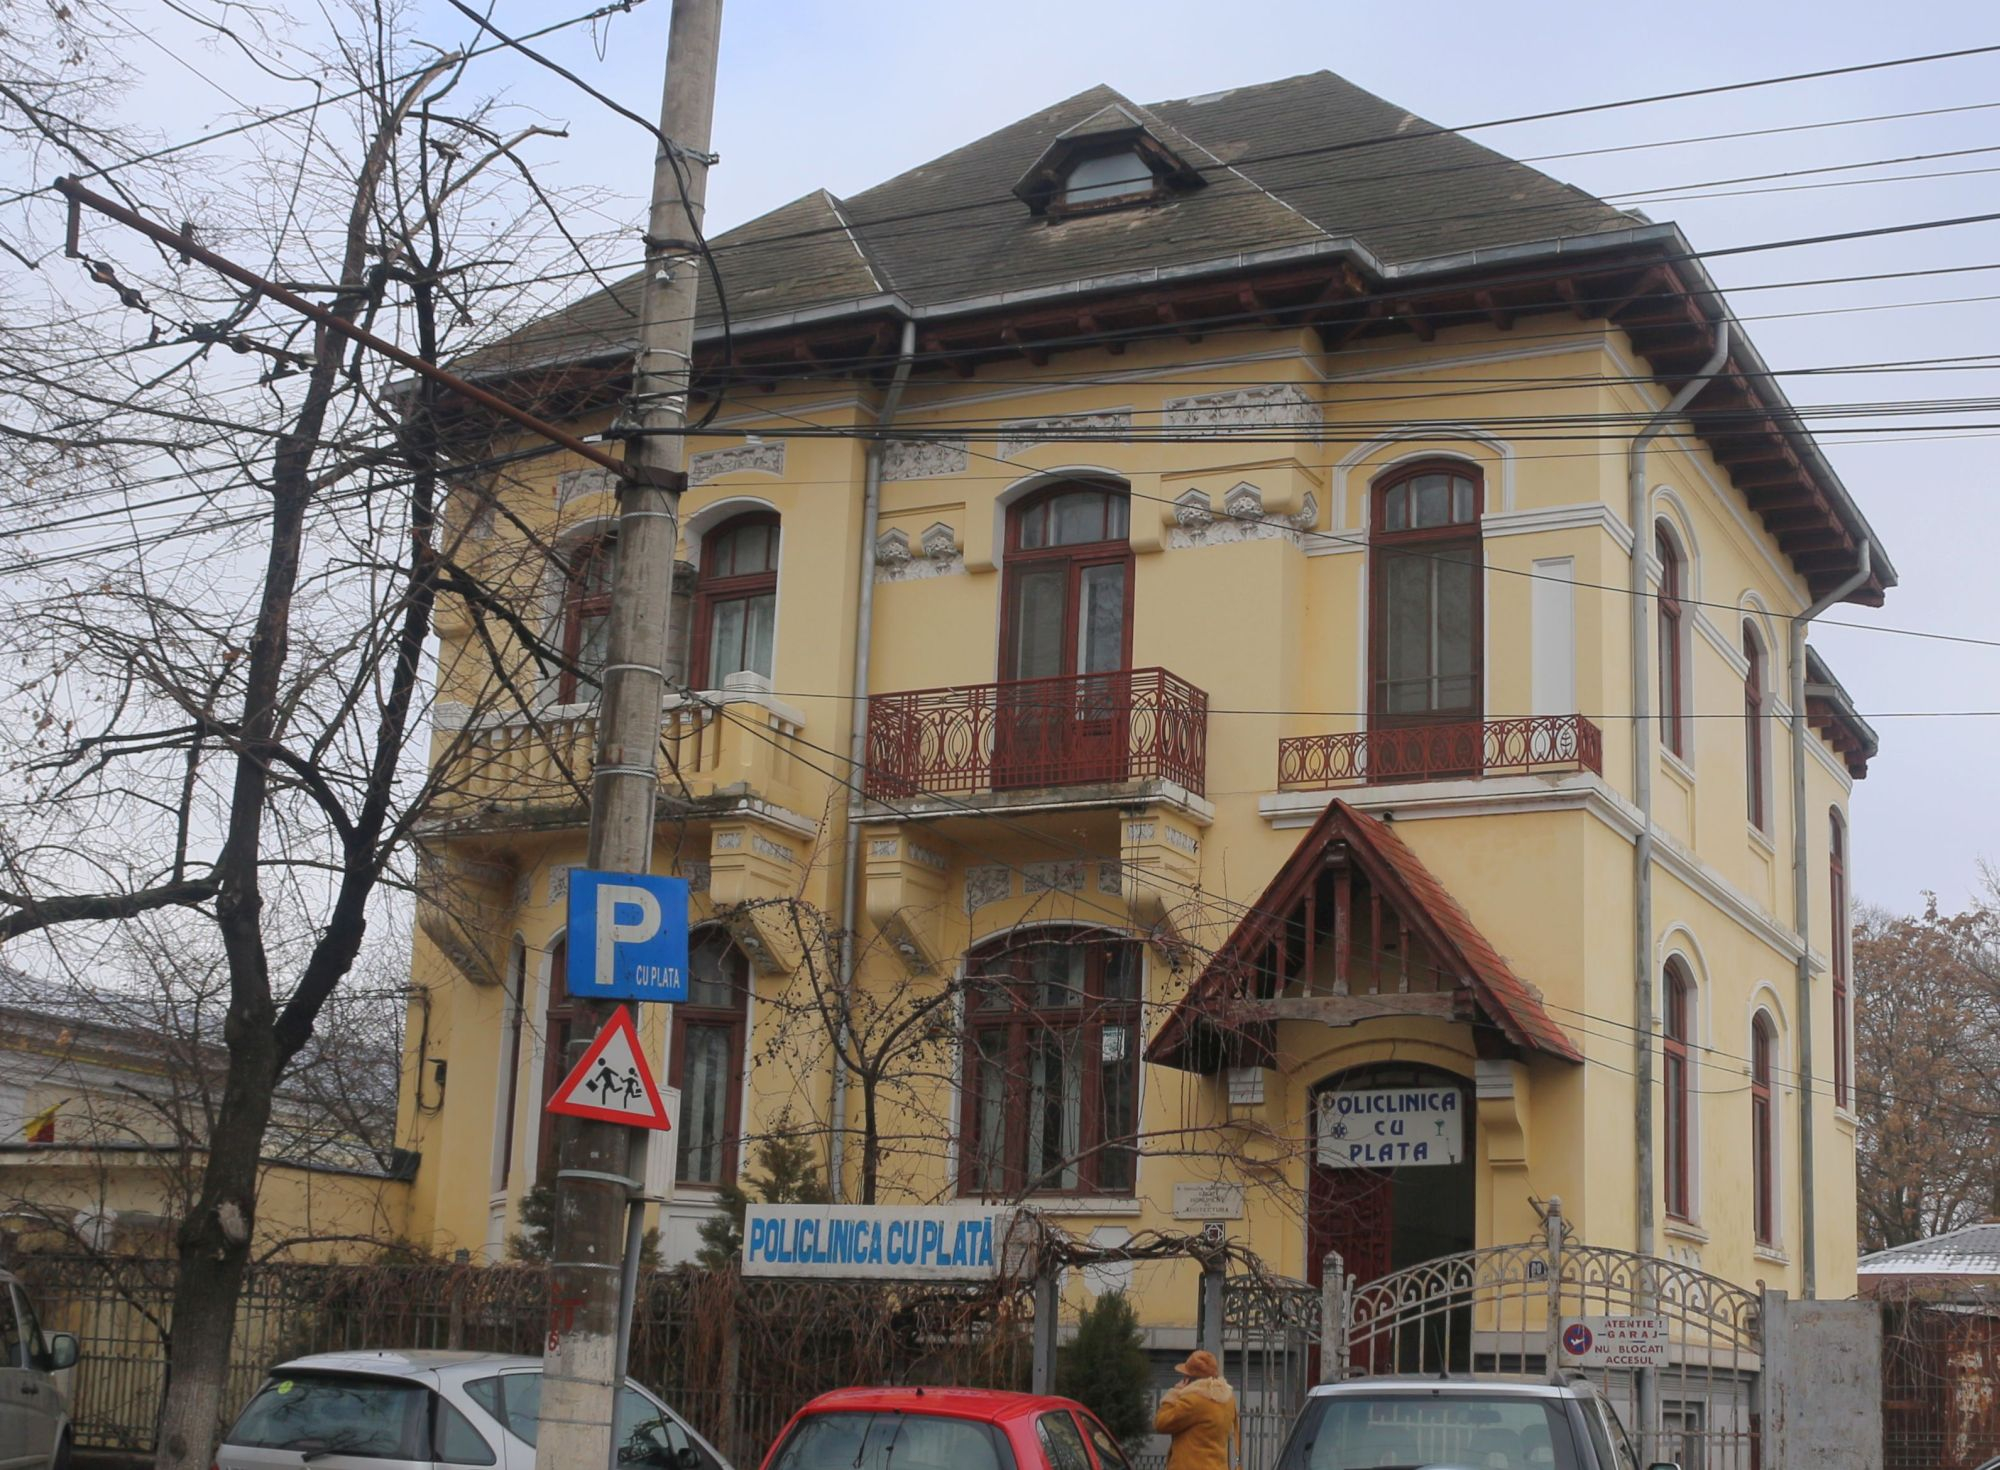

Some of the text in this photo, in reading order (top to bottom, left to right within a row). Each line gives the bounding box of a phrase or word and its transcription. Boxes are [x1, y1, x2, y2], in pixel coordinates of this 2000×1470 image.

[595, 884, 661, 985] P
[636, 964, 680, 988] CU PLATA
[1374, 1119, 1404, 1135] CU
[1350, 1141, 1428, 1163] PLATA
[750, 1216, 993, 1266] POLICLINICA CU PLATĂ
[1605, 1320, 1654, 1328] ATENTIE
[1594, 1345, 1664, 1353] NU BLOCATI
[1606, 1356, 1654, 1364] ACCESUL
